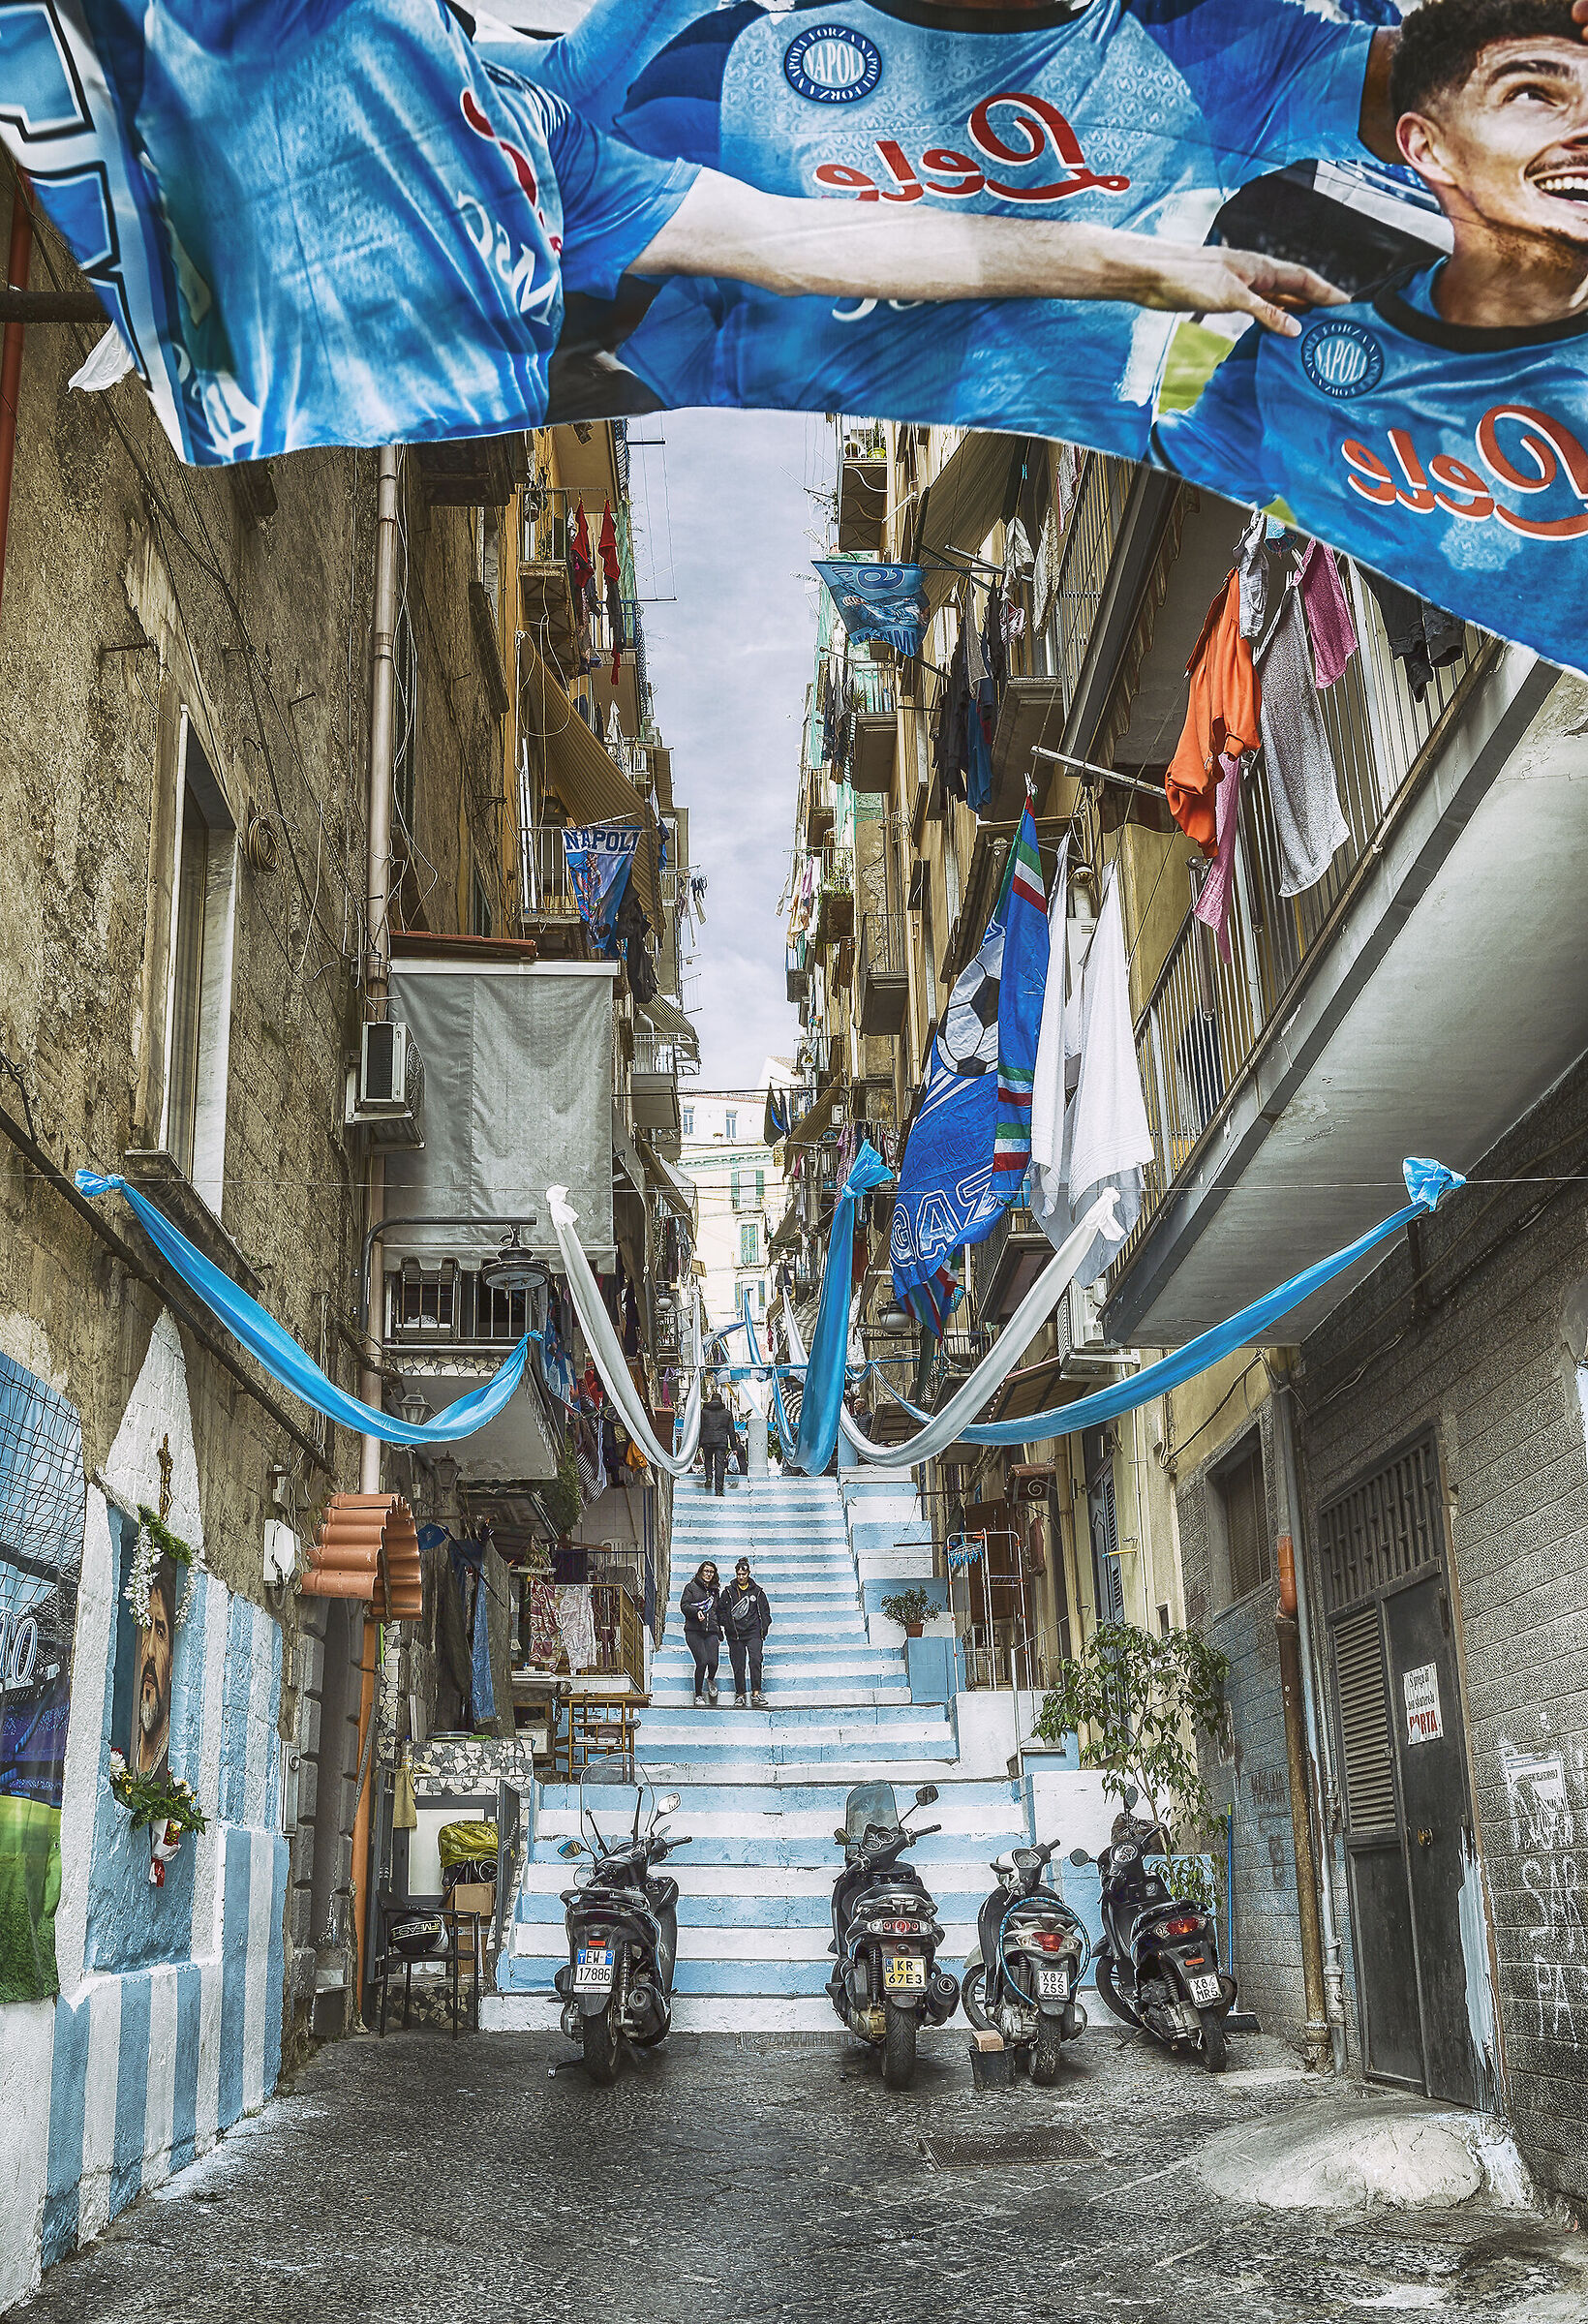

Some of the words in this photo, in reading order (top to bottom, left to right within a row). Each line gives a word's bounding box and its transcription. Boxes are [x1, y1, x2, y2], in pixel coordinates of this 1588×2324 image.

[805, 42, 865, 83] NAPOLI
[565, 829, 639, 852] NAPOLI
[587, 1950, 600, 1964] EW
[897, 1960, 913, 1972] KR
[579, 1967, 611, 1981] 17886
[888, 1973, 922, 1985] 67E3
[1042, 1972, 1064, 1983] X8Z
[1043, 1982, 1064, 1994] Z5S
[1196, 1986, 1218, 2002] MR5
